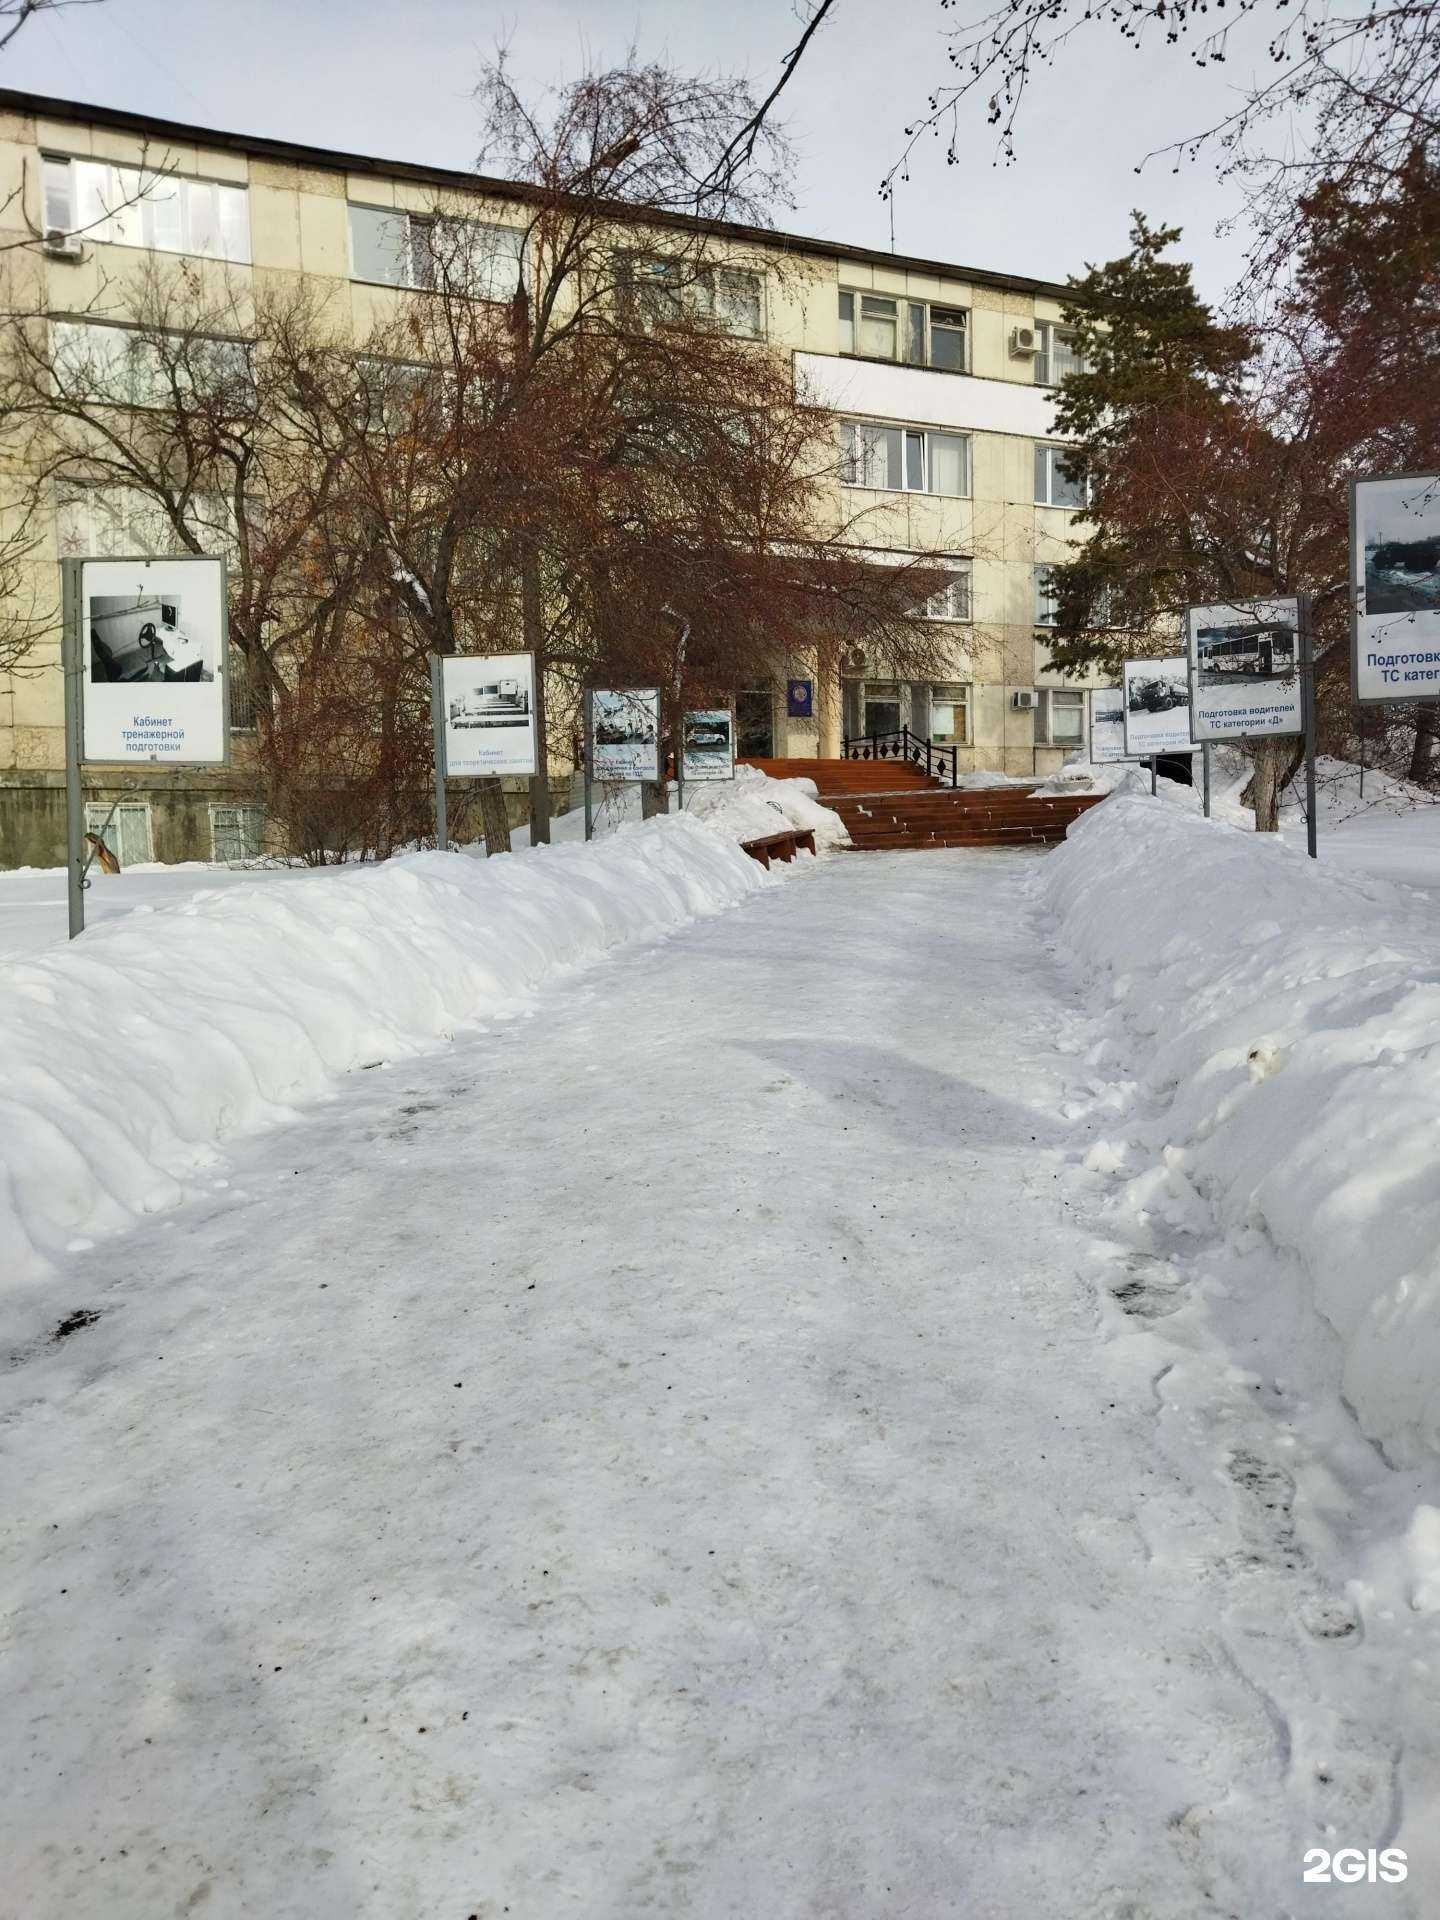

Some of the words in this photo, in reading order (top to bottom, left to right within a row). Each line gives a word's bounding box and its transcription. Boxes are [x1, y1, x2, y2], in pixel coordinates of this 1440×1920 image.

[1381, 669, 1400, 683] ТС
[1404, 669, 1440, 682] катег
[1198, 708, 1247, 719] Подготовка
[1249, 703, 1295, 715] водителей
[133, 715, 173, 727] Кабинет
[1209, 720, 1221, 729] ТС
[1223, 718, 1266, 728] категории
[1268, 716, 1283, 725] «Д»
[121, 728, 185, 741] тренажерной
[126, 743, 181, 753] подготовки
[449, 760, 462, 768] для
